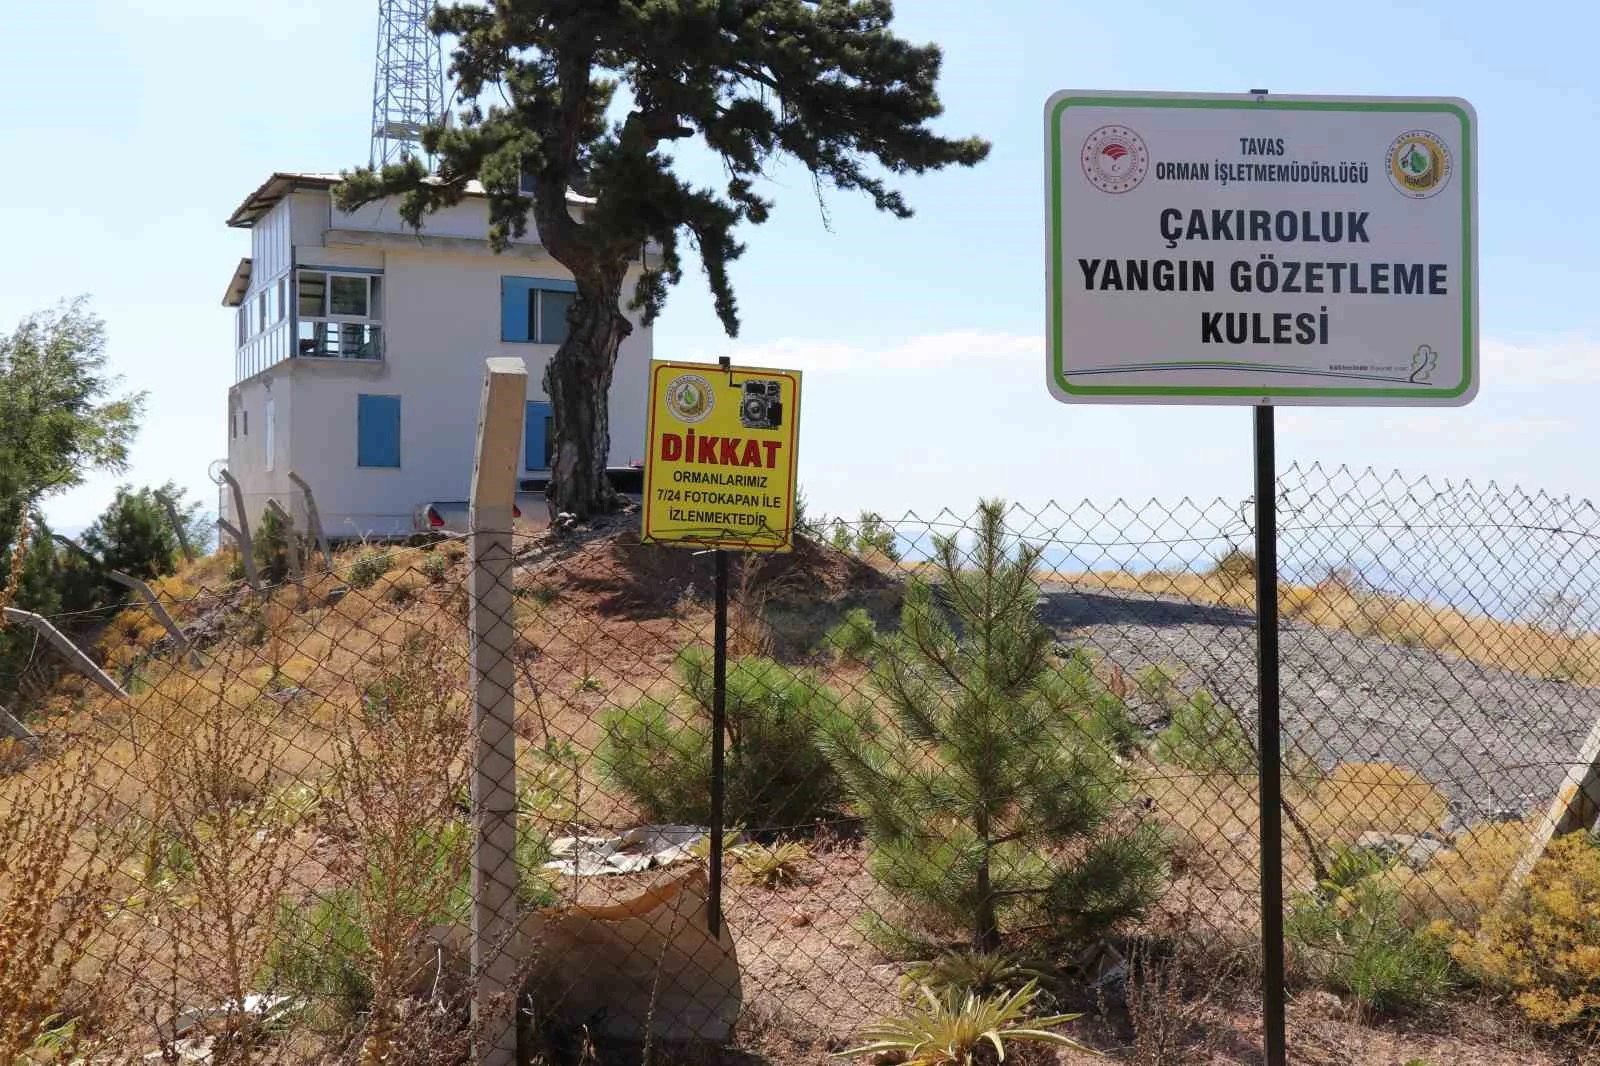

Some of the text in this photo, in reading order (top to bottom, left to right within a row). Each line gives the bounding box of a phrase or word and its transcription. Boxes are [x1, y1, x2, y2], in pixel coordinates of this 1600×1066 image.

[1240, 138, 1285, 156] TAVAS
[1156, 159, 1369, 186] ORMAN İŞLETMEMÜDÜRLÜĞÜ
[1160, 208, 1370, 248] ÇAKIROLUK
[1078, 254, 1448, 295] YANGIN GÖZETLEME
[1201, 305, 1329, 345] KULESİ
[661, 428, 782, 468] DİKKAT
[673, 471, 767, 488] ORMANLARIMIZ
[657, 489, 781, 508] 7/24 FOTOKAPAN İLE
[669, 506, 767, 527] İZLENMEKTEDİR
